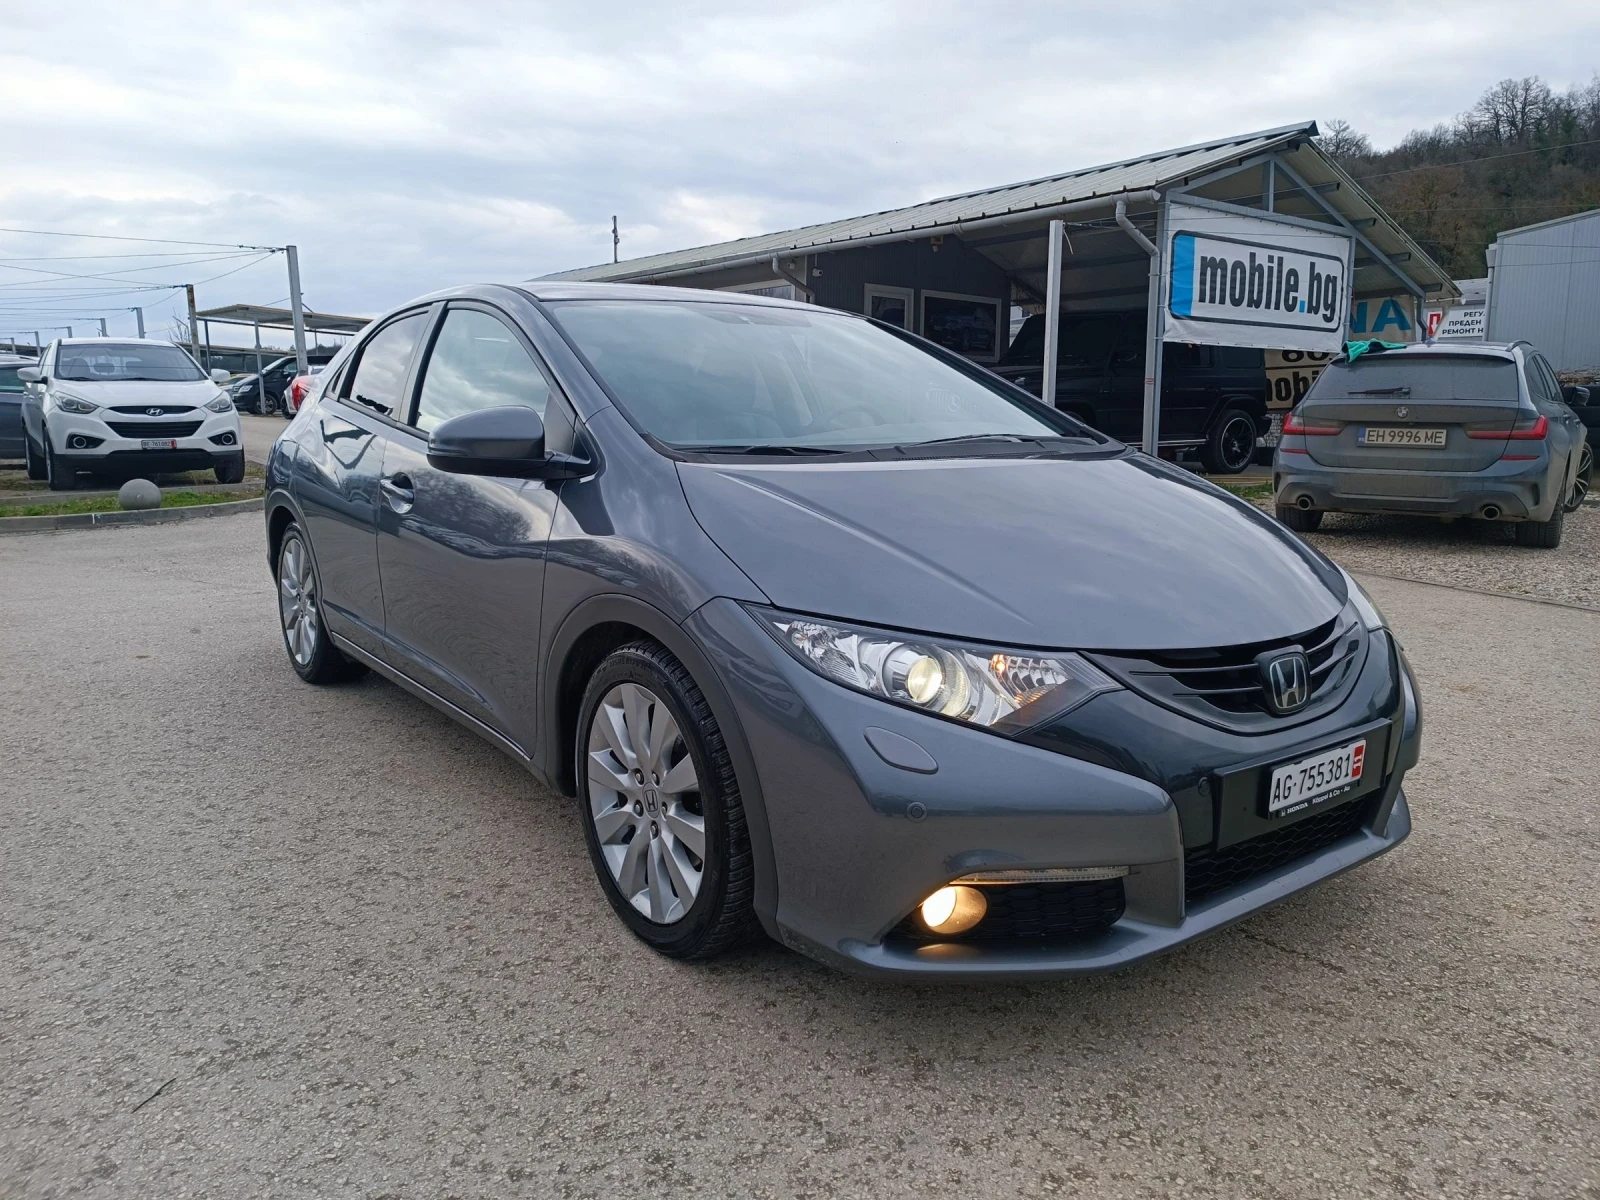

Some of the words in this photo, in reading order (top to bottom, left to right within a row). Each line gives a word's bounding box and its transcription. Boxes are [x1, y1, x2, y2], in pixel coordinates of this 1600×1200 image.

[1199, 252, 1338, 323] mobile.bg
[1366, 429, 1386, 442] EH
[1388, 430, 1422, 443] 9996
[1424, 430, 1444, 444] ME
[1287, 802, 1309, 814] HONDA
